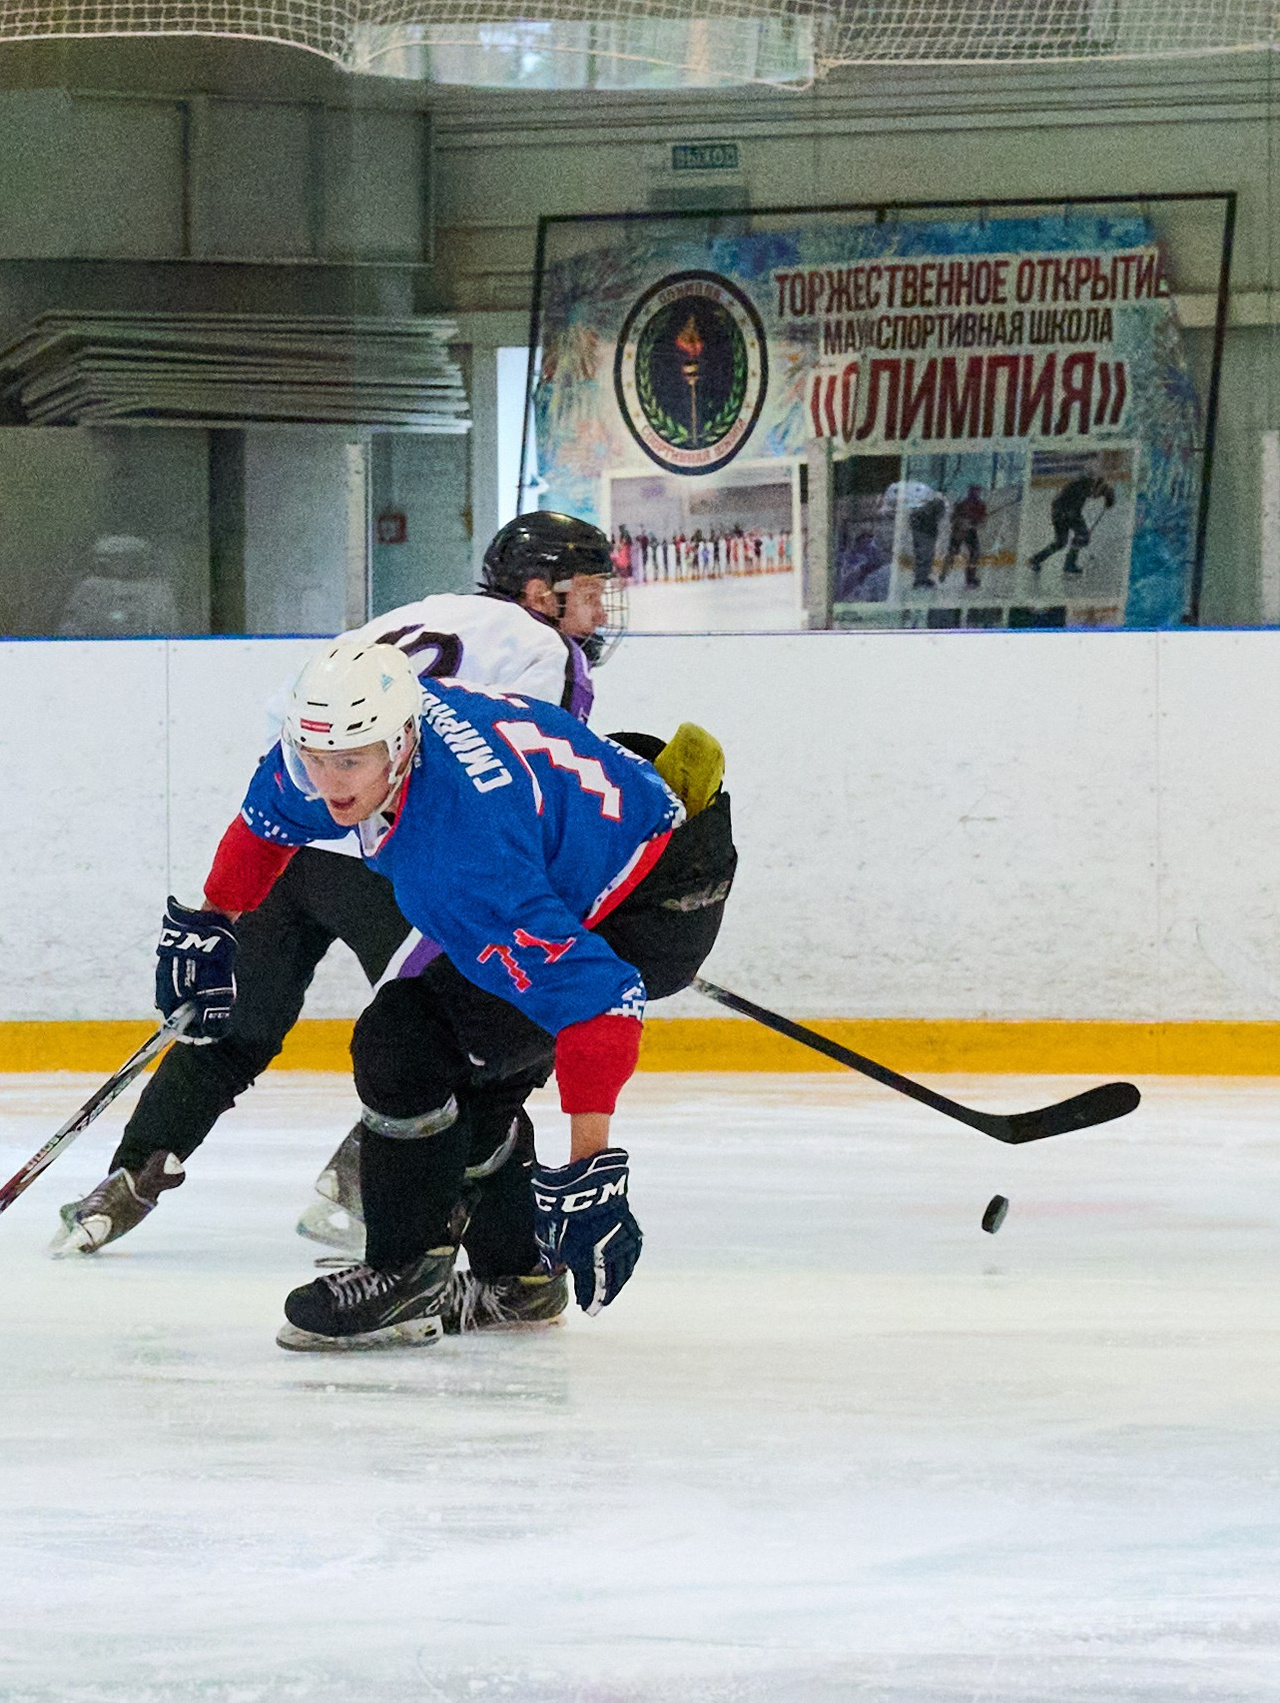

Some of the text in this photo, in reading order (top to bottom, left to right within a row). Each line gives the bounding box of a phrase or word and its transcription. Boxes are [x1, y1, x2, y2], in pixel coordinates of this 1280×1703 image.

[775, 259, 1010, 317] ТОРЖЕСТВЕННОЕ
[1029, 307, 1113, 346] ШКОЛА
[420, 691, 513, 794] СМИРНО
[535, 1174, 627, 1214] CCM
